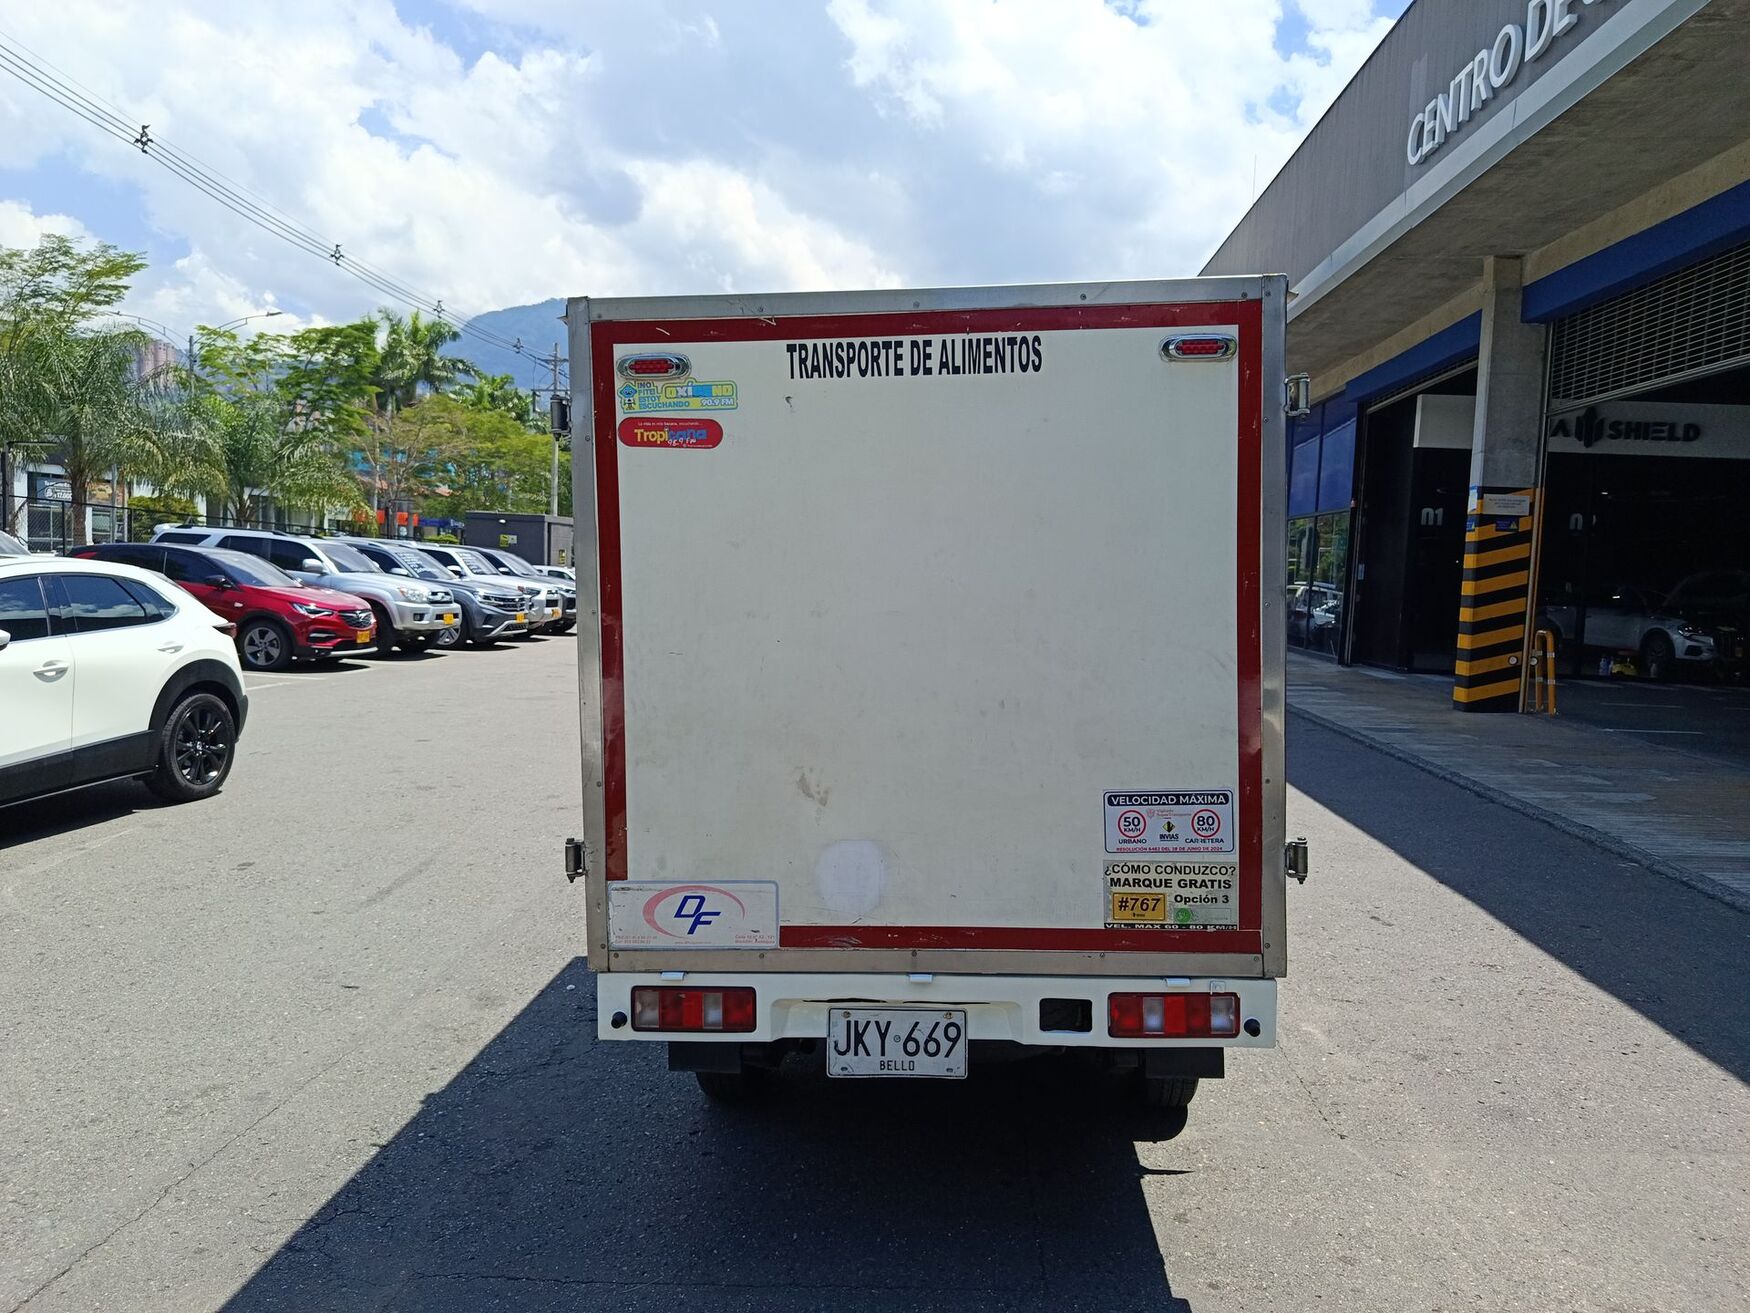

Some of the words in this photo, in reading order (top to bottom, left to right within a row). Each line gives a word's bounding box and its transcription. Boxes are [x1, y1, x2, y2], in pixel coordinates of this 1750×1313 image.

[1407, 24, 1522, 166] CENTRO
[786, 340, 904, 380] TRANSPORTE
[911, 339, 933, 376] DE
[938, 335, 1043, 376] ALIMENTOS
[639, 401, 690, 409] ESCUCHANDO
[1111, 795, 1177, 805] VELOCIDAD
[1179, 793, 1226, 804] MÁXIMA
[1123, 816, 1141, 828] 50
[1196, 815, 1215, 827] 80
[1104, 863, 1151, 876] ¿CÓMO
[1155, 865, 1237, 876] CONDUZCO?
[1110, 877, 1173, 889] MARQUE
[1177, 878, 1232, 889] GRATIS
[1118, 896, 1161, 912] #767
[1174, 894, 1218, 905] Opción
[1222, 894, 1230, 904] 3
[673, 895, 721, 935] DF
[834, 1020, 892, 1057] JKY
[902, 1021, 962, 1059] 669
[879, 1060, 915, 1071] BELLO
